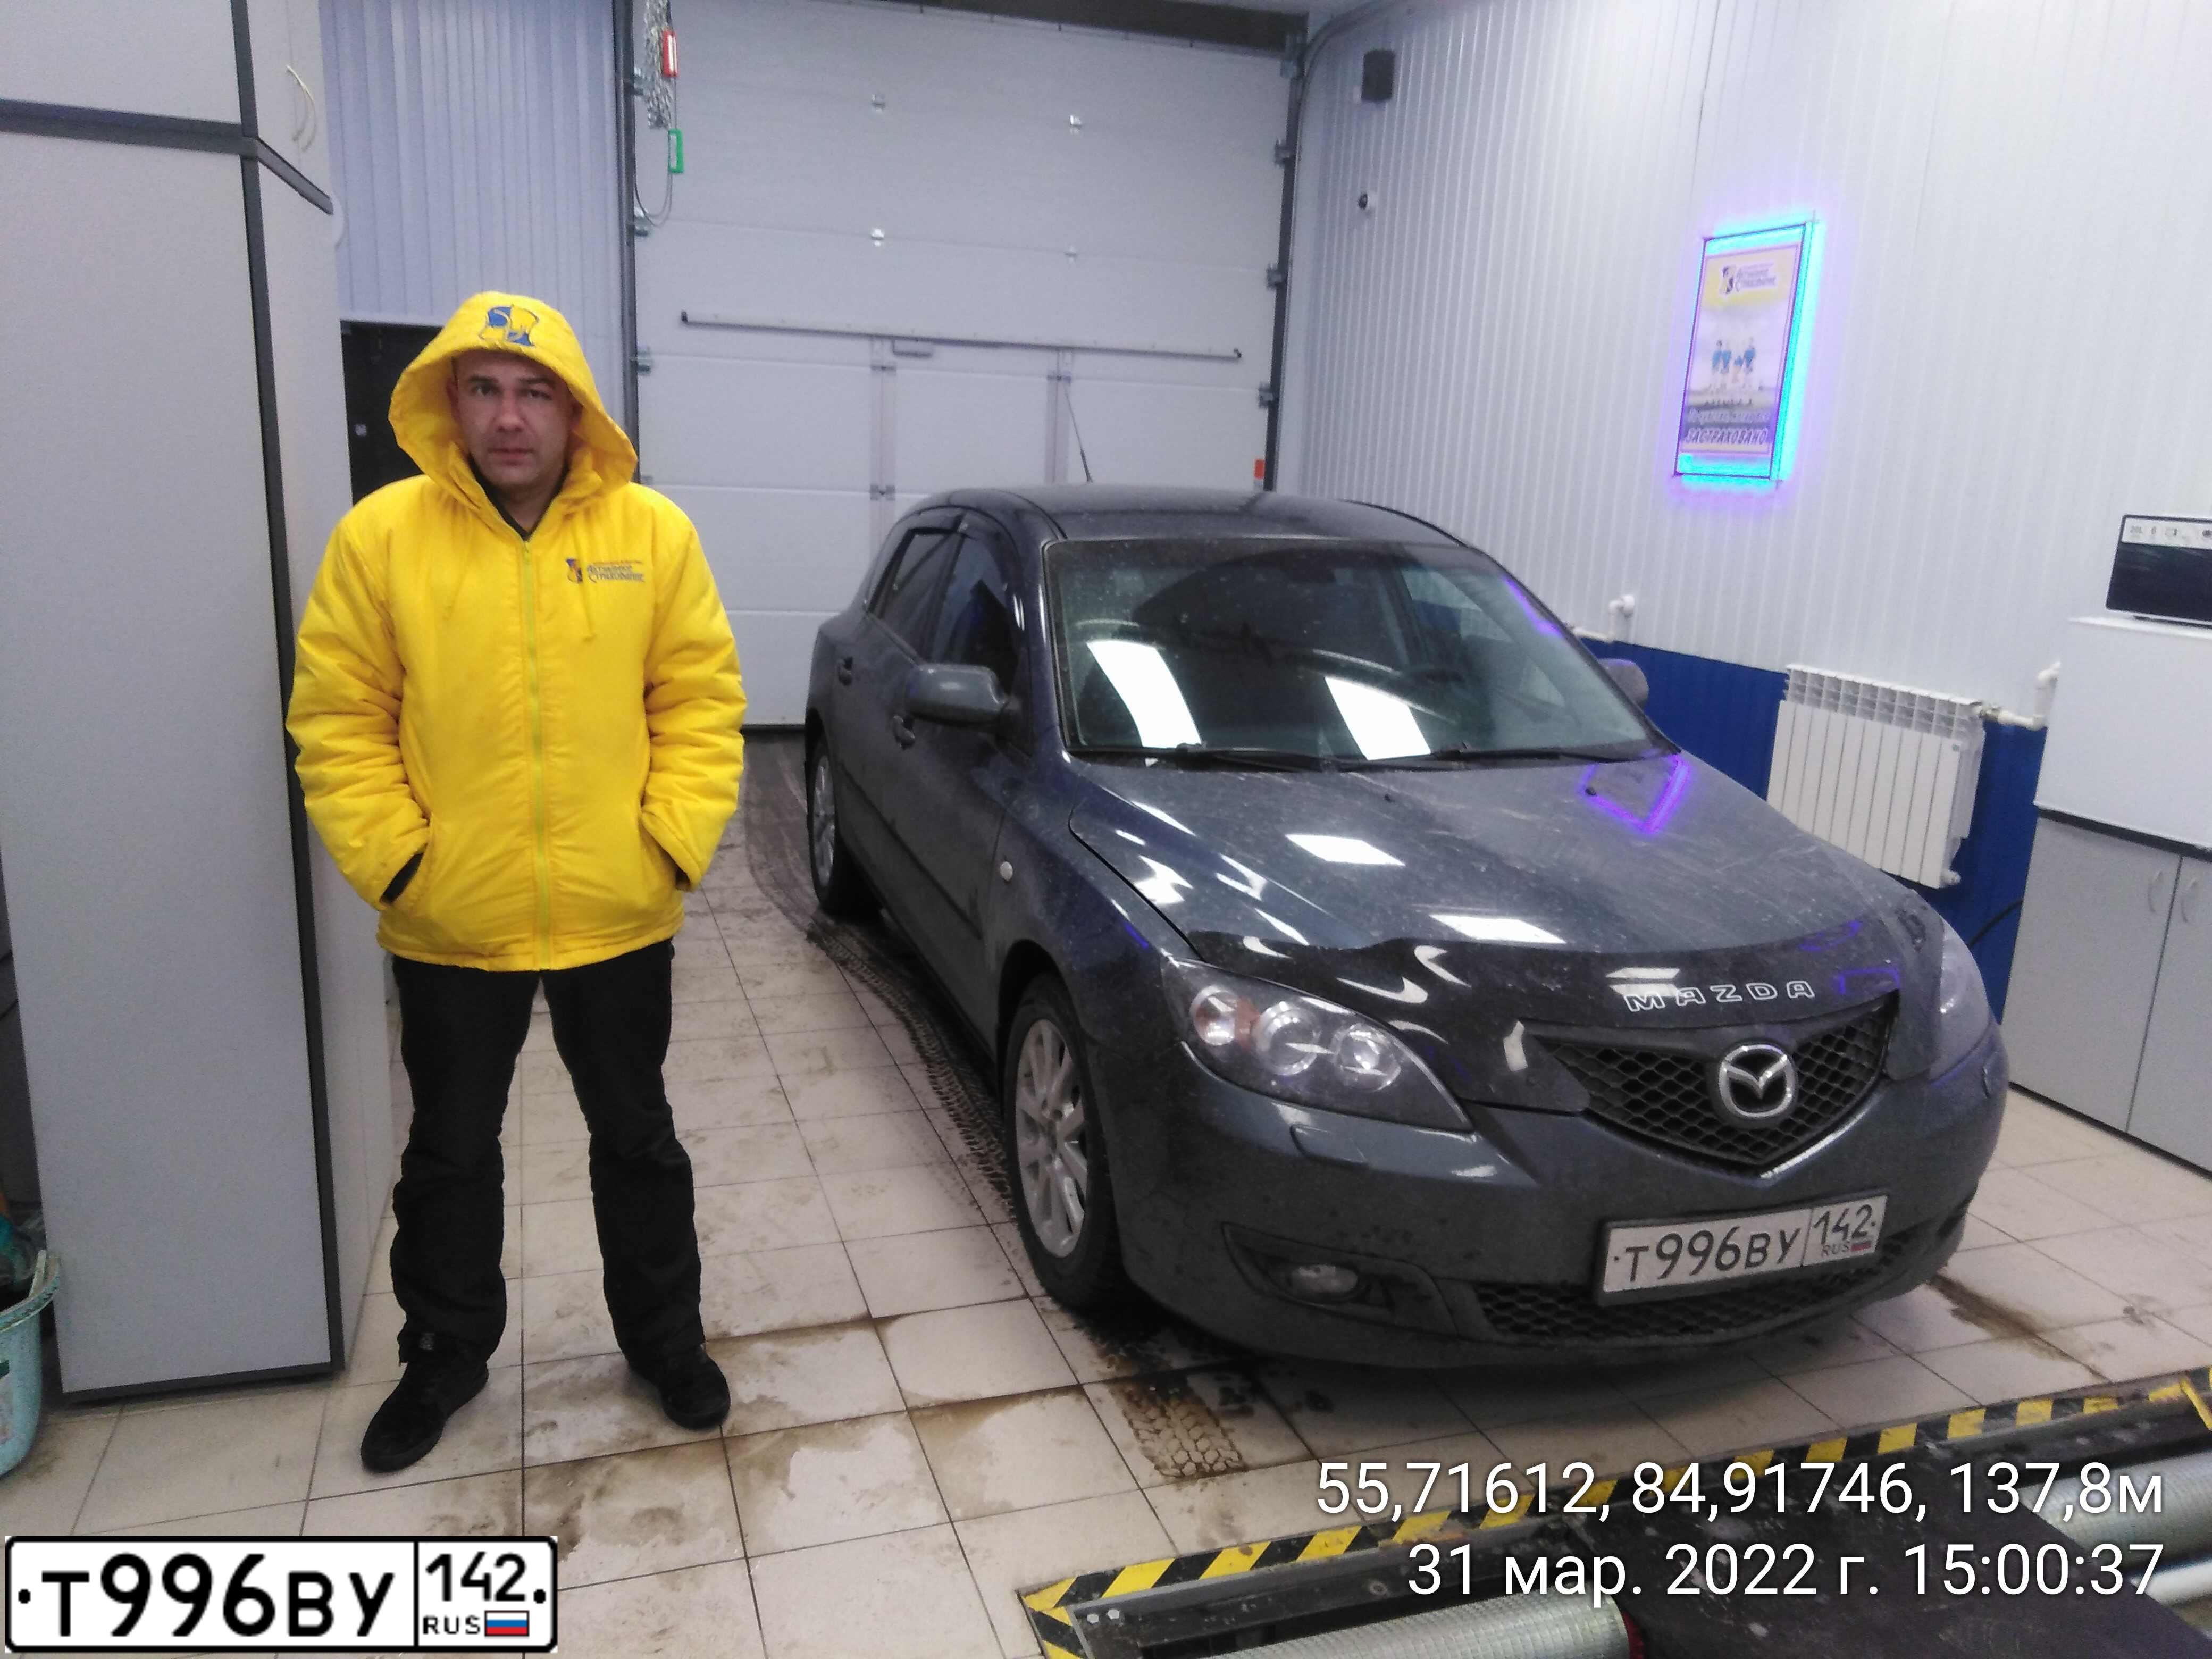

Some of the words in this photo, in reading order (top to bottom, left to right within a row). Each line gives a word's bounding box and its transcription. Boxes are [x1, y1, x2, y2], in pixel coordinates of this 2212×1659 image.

[1623, 981, 1814, 1012] MAZDA
[1625, 1226, 1800, 1282] Т996ВУ
[1813, 1204, 1873, 1245] 142
[1821, 1242, 1850, 1256] RUS
